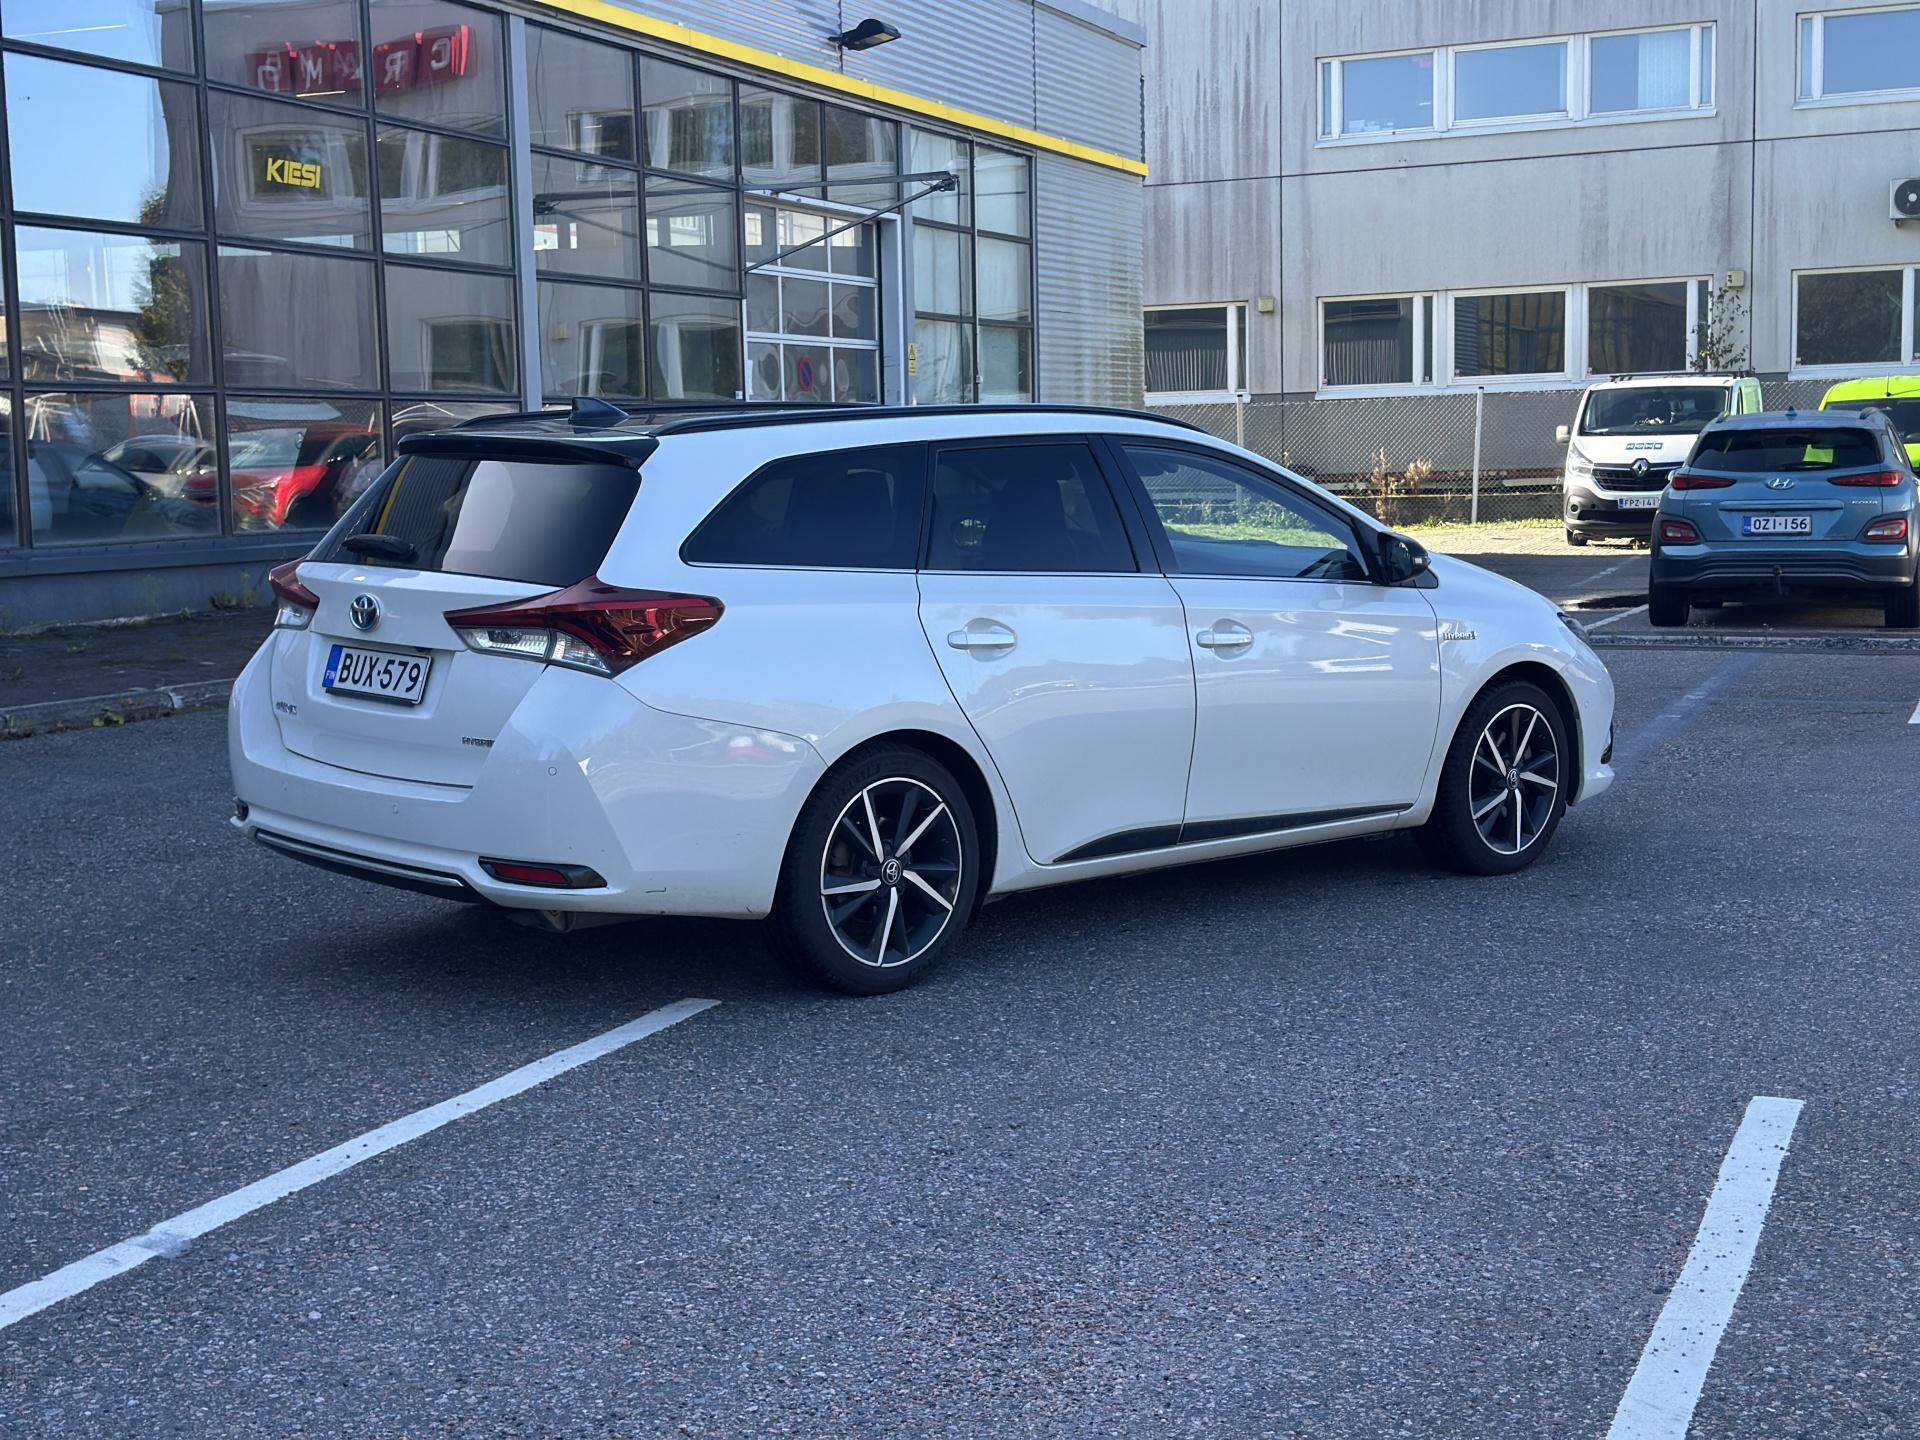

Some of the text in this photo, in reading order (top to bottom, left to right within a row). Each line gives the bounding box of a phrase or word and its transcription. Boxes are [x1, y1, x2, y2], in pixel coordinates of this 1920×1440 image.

[266, 157, 321, 189] KIESI
[1753, 518, 1808, 530] OZI-156
[338, 653, 421, 693] BUX-579
